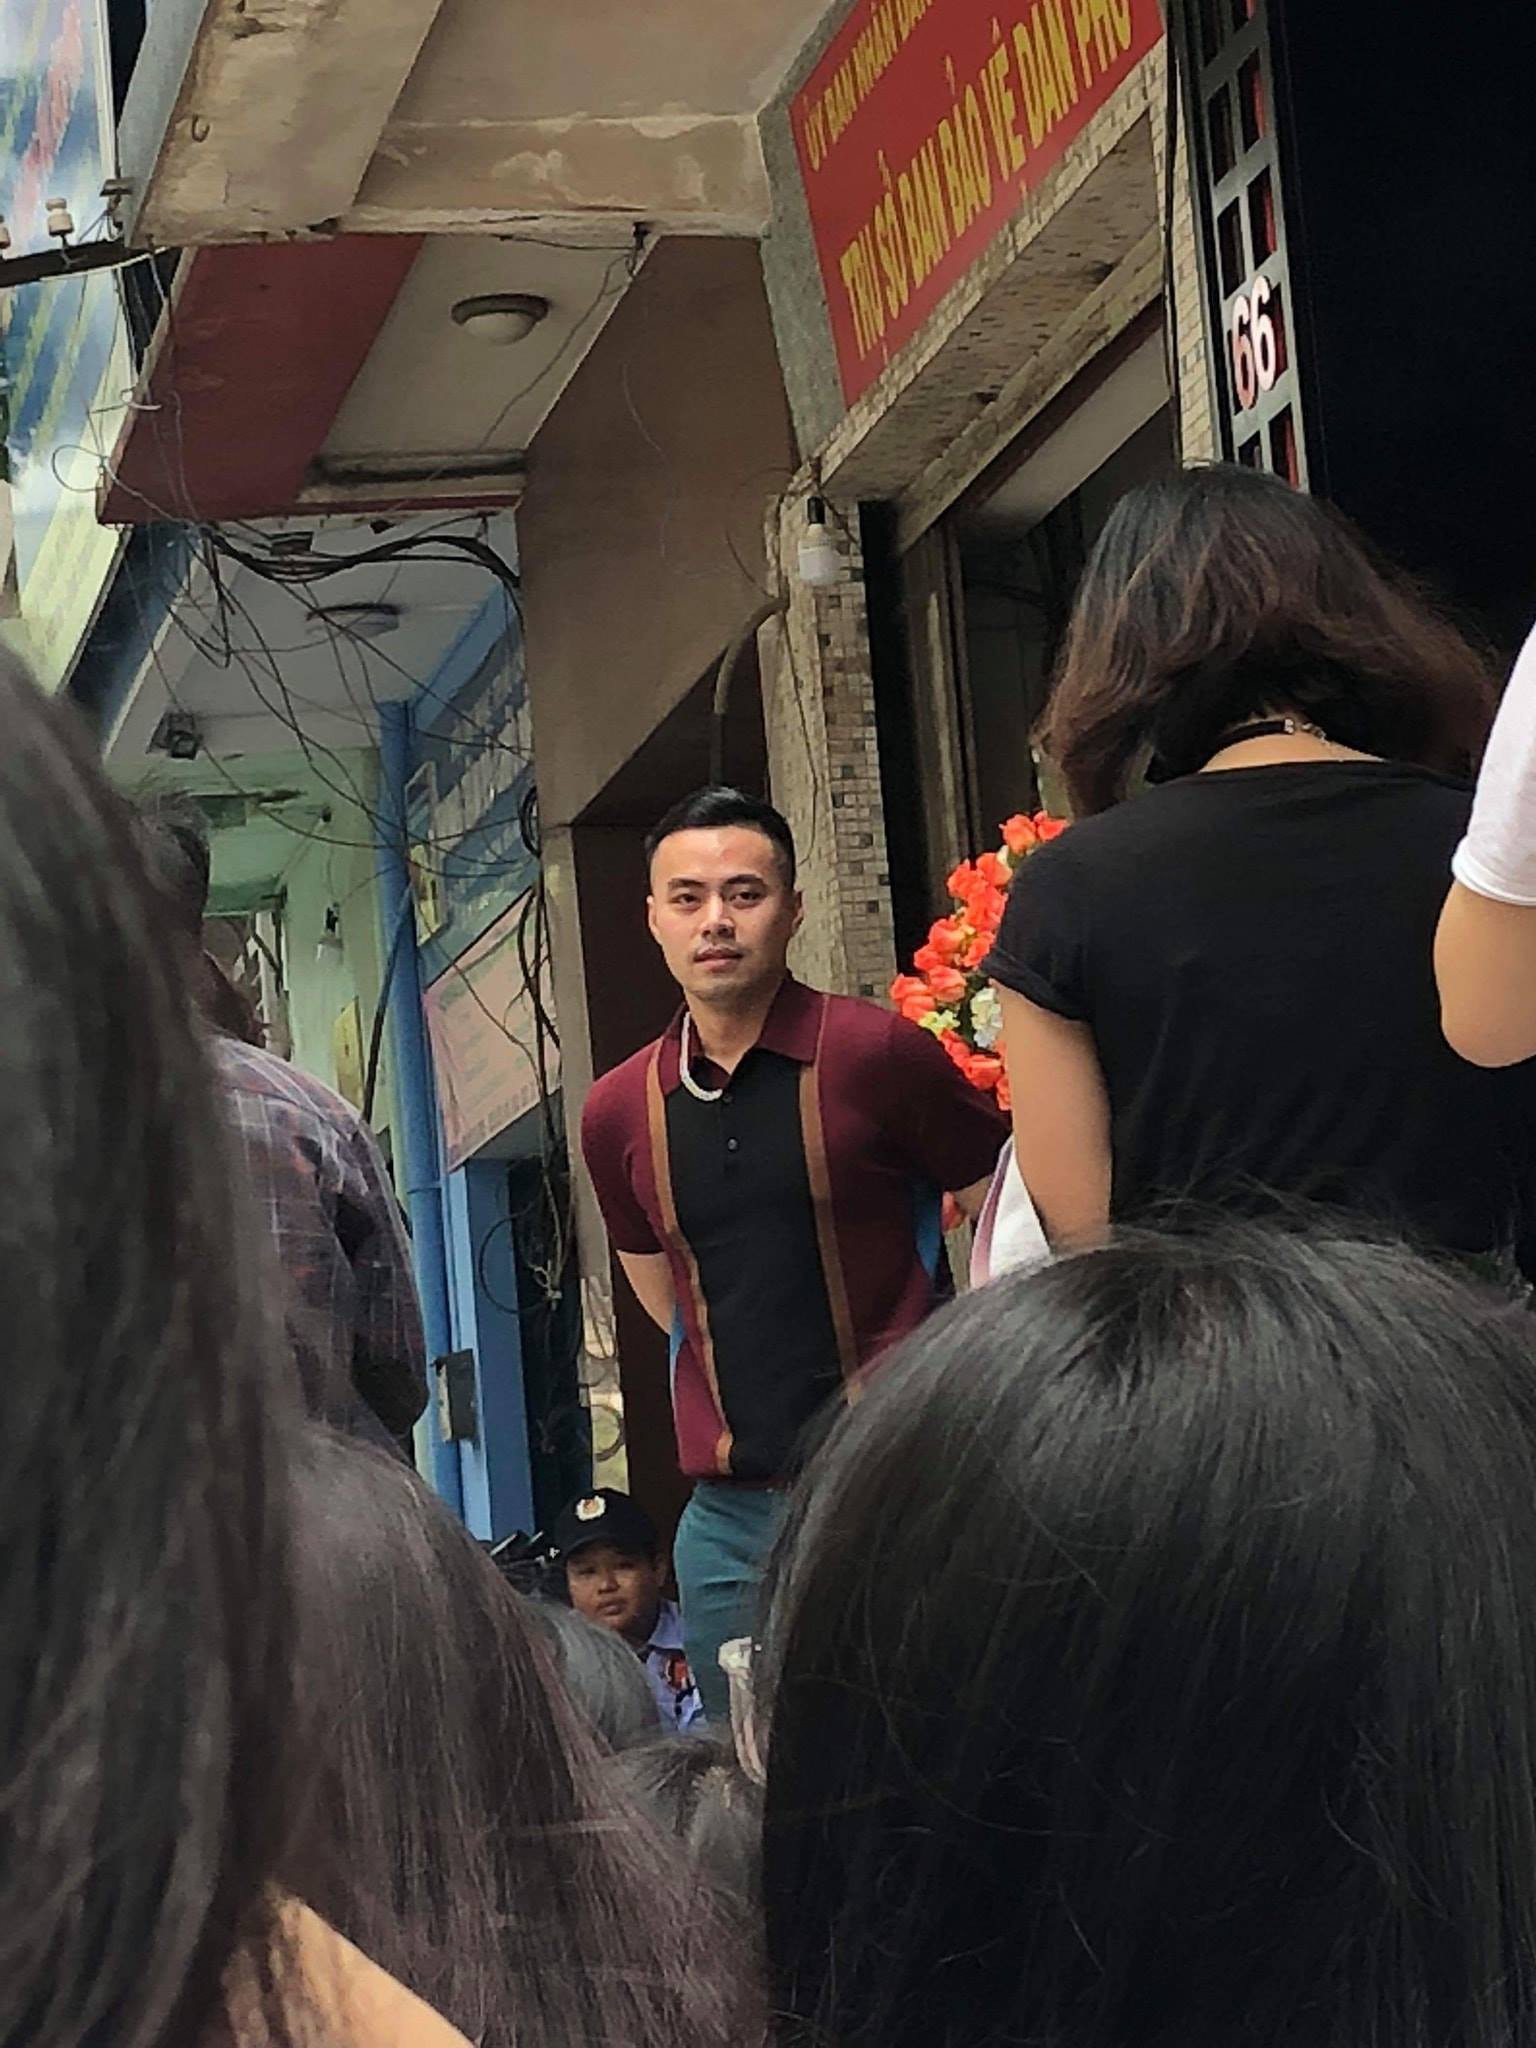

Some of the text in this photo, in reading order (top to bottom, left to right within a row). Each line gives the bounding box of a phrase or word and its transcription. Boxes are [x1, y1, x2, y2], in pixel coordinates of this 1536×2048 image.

[824, 61, 857, 145] BAN
[898, 136, 952, 290] BAN
[937, 55, 993, 239] BẢO
[1231, 275, 1278, 412] 66
